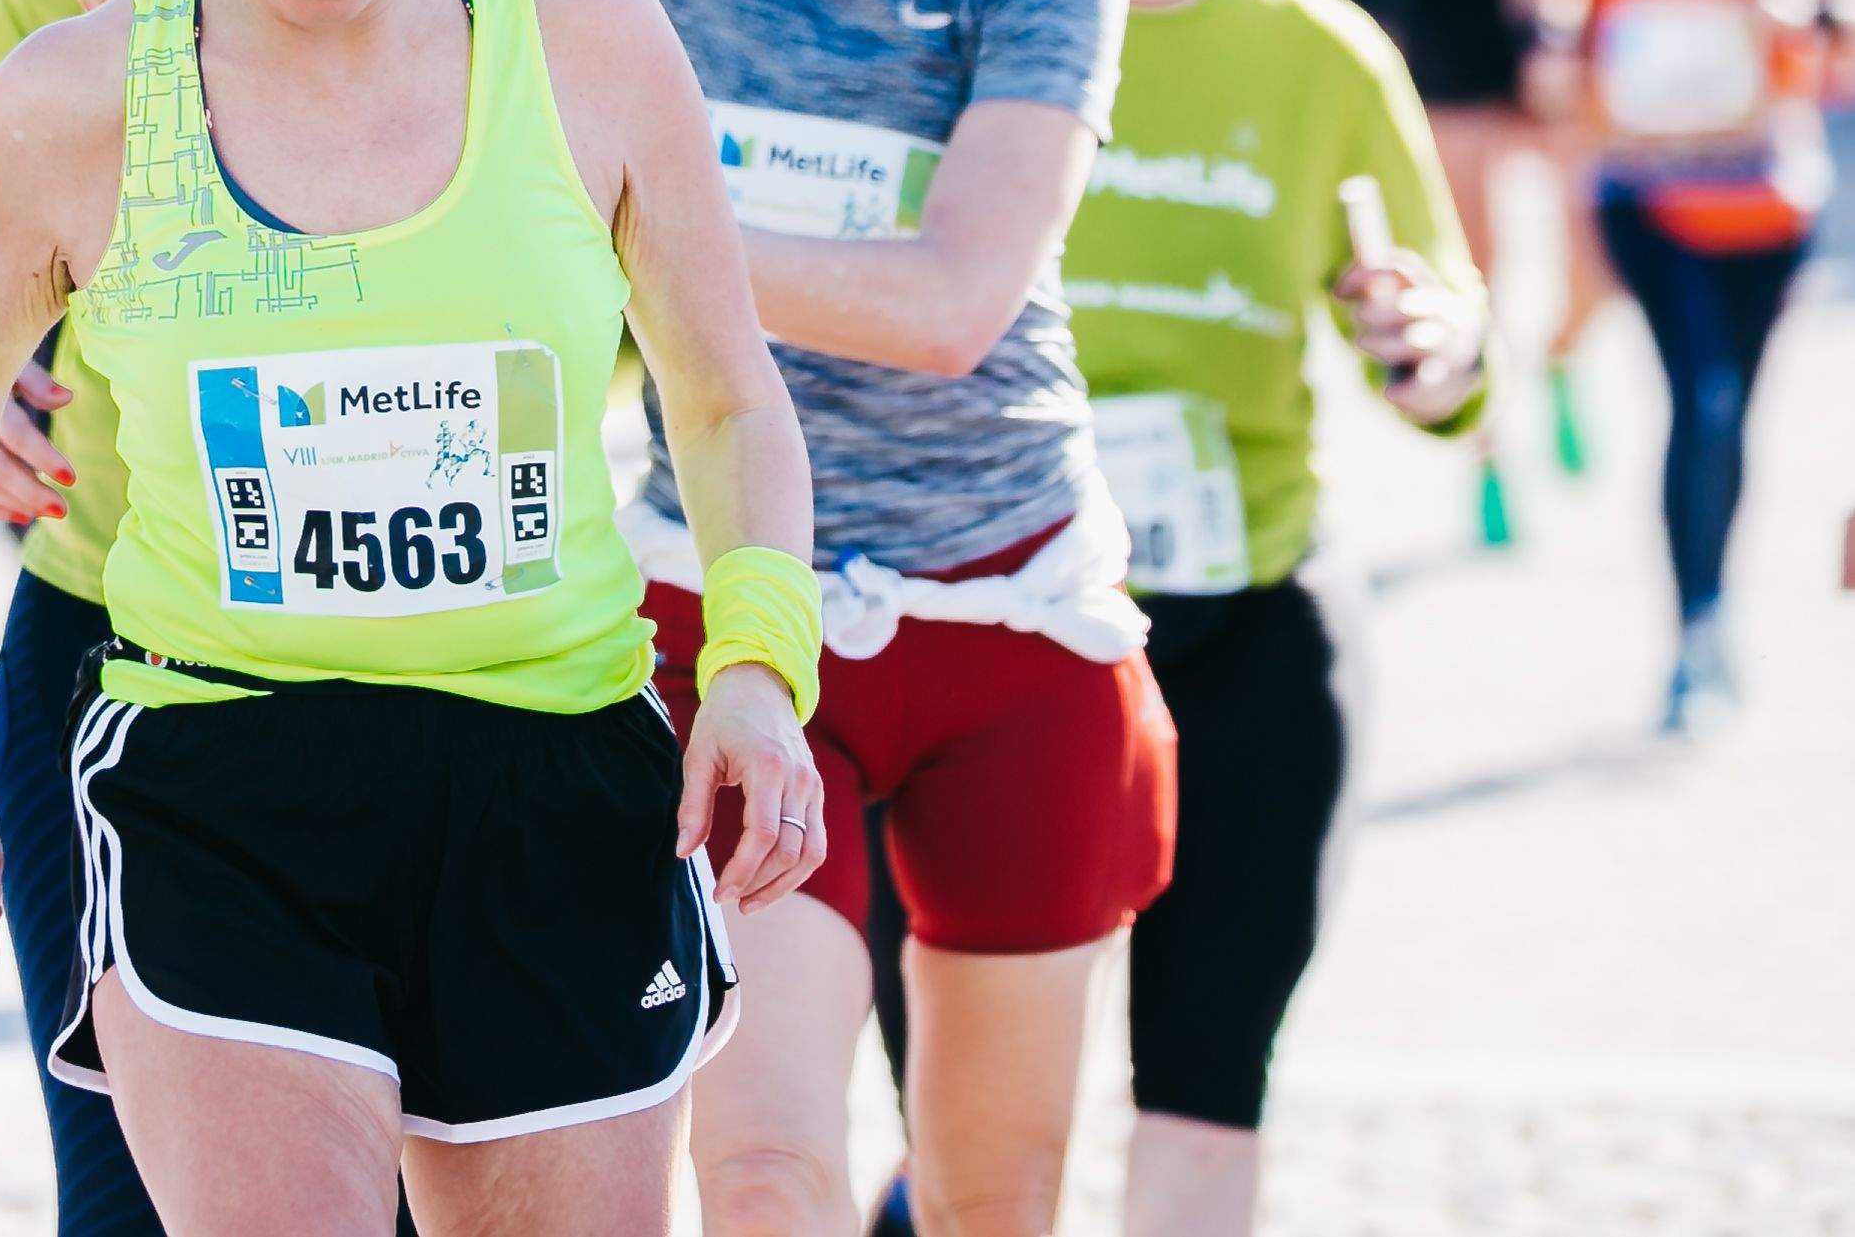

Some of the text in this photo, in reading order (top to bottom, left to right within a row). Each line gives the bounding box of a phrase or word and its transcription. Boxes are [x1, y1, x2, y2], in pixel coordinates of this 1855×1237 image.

[770, 146, 888, 183] MetLife
[340, 380, 482, 416] MetLife
[283, 446, 318, 466] VIII
[293, 502, 487, 593] 4563
[640, 983, 686, 1009] adidas
